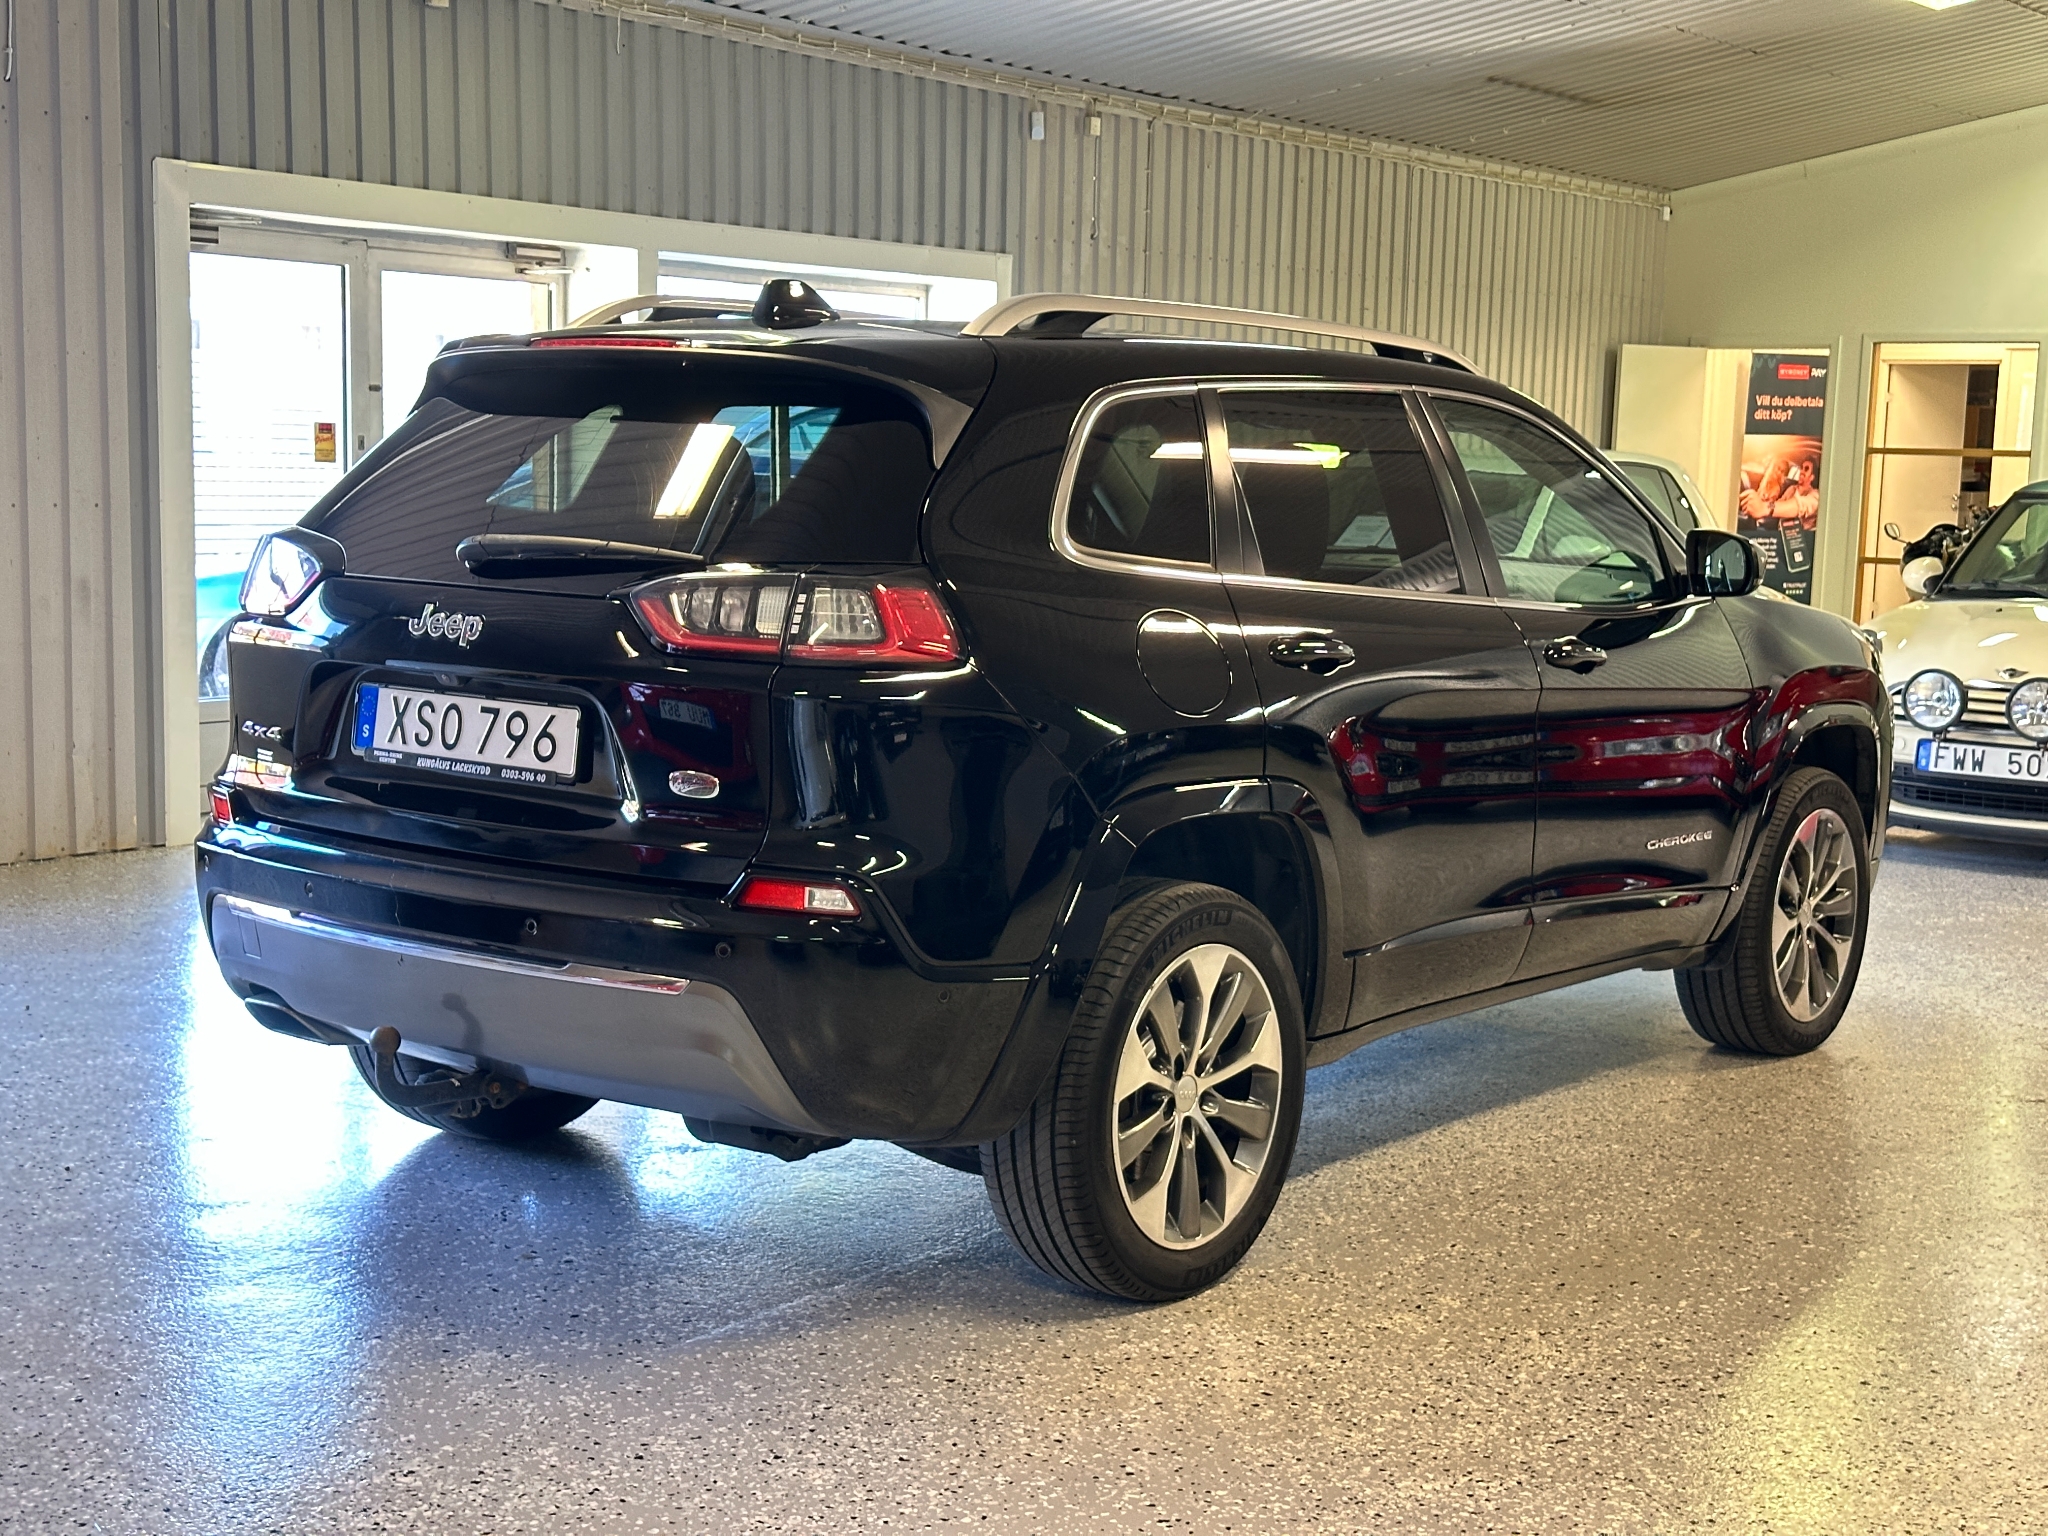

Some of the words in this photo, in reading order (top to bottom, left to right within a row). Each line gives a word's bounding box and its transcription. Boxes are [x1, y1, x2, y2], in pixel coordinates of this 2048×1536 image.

[1756, 394, 1771, 406] Vill
[1771, 395, 1783, 407] du
[1784, 395, 1824, 408] delbetala
[1754, 408, 1770, 420] ditt
[1771, 408, 1793, 423] köp?
[409, 603, 483, 647] Jeep
[242, 720, 282, 741] 4x4
[362, 724, 370, 738] S
[386, 694, 463, 750] XSO
[476, 704, 557, 763] 796
[417, 757, 451, 771] KUNGÄLVS
[451, 763, 491, 776] LACKSKYDD
[501, 768, 535, 782] 0303-596
[536, 773, 546, 783] 40
[1934, 743, 1986, 773] FWW
[2008, 752, 2048, 777] 50
[1646, 830, 1713, 850] CHEROKEE
